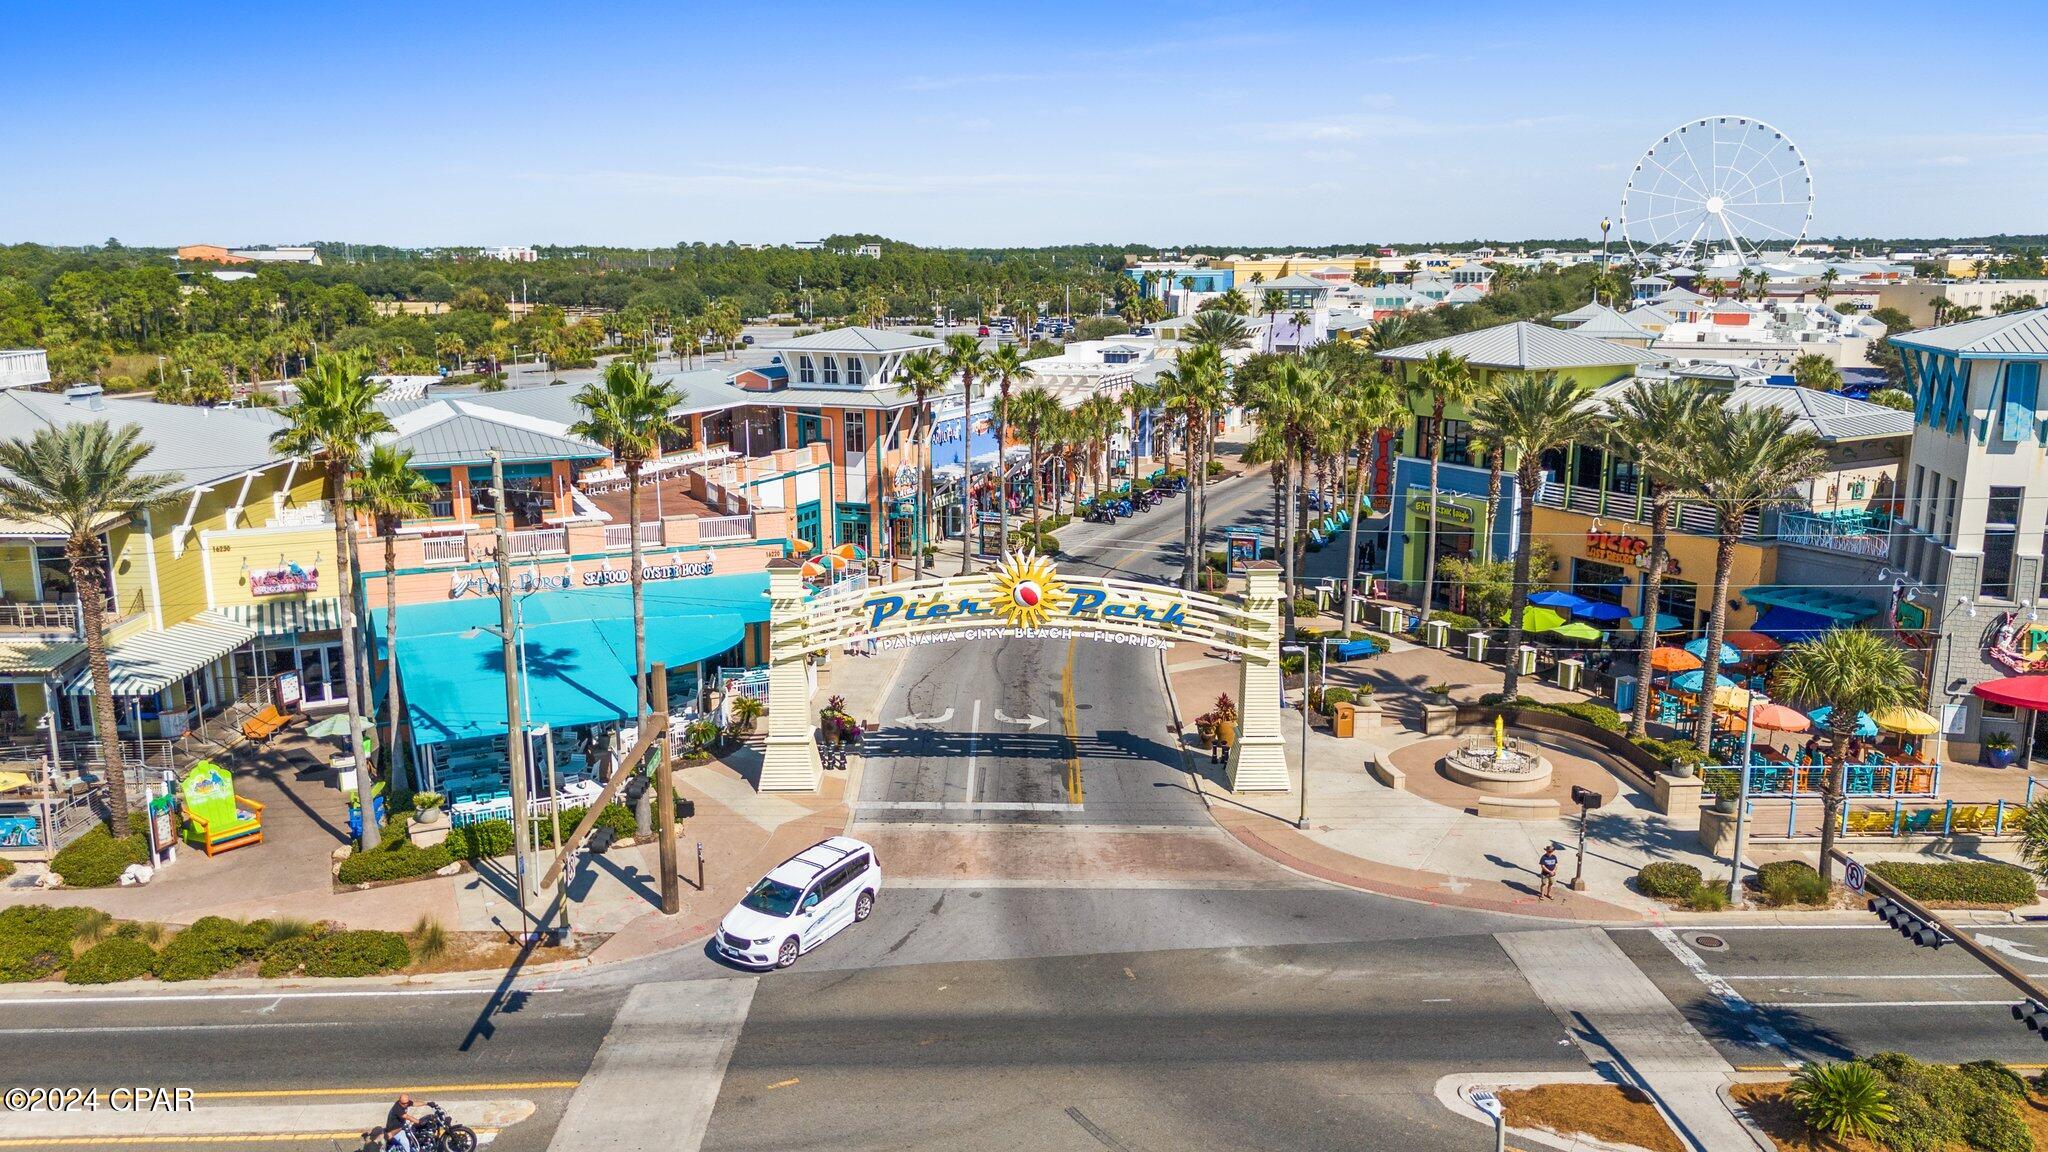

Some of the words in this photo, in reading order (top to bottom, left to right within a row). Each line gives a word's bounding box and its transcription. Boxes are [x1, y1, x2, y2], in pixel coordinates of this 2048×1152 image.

[478, 576, 517, 592] BAK
[583, 569, 629, 586] SEAFOOD
[642, 564, 680, 580] OYSTER
[680, 562, 714, 578] HOUSE
[863, 595, 993, 629] Pier
[1065, 587, 1199, 629] Park
[883, 630, 957, 650] PANAMA
[963, 627, 1006, 641] CITY
[1014, 627, 1072, 640] BEACH
[1093, 630, 1168, 650] FLORIDA
